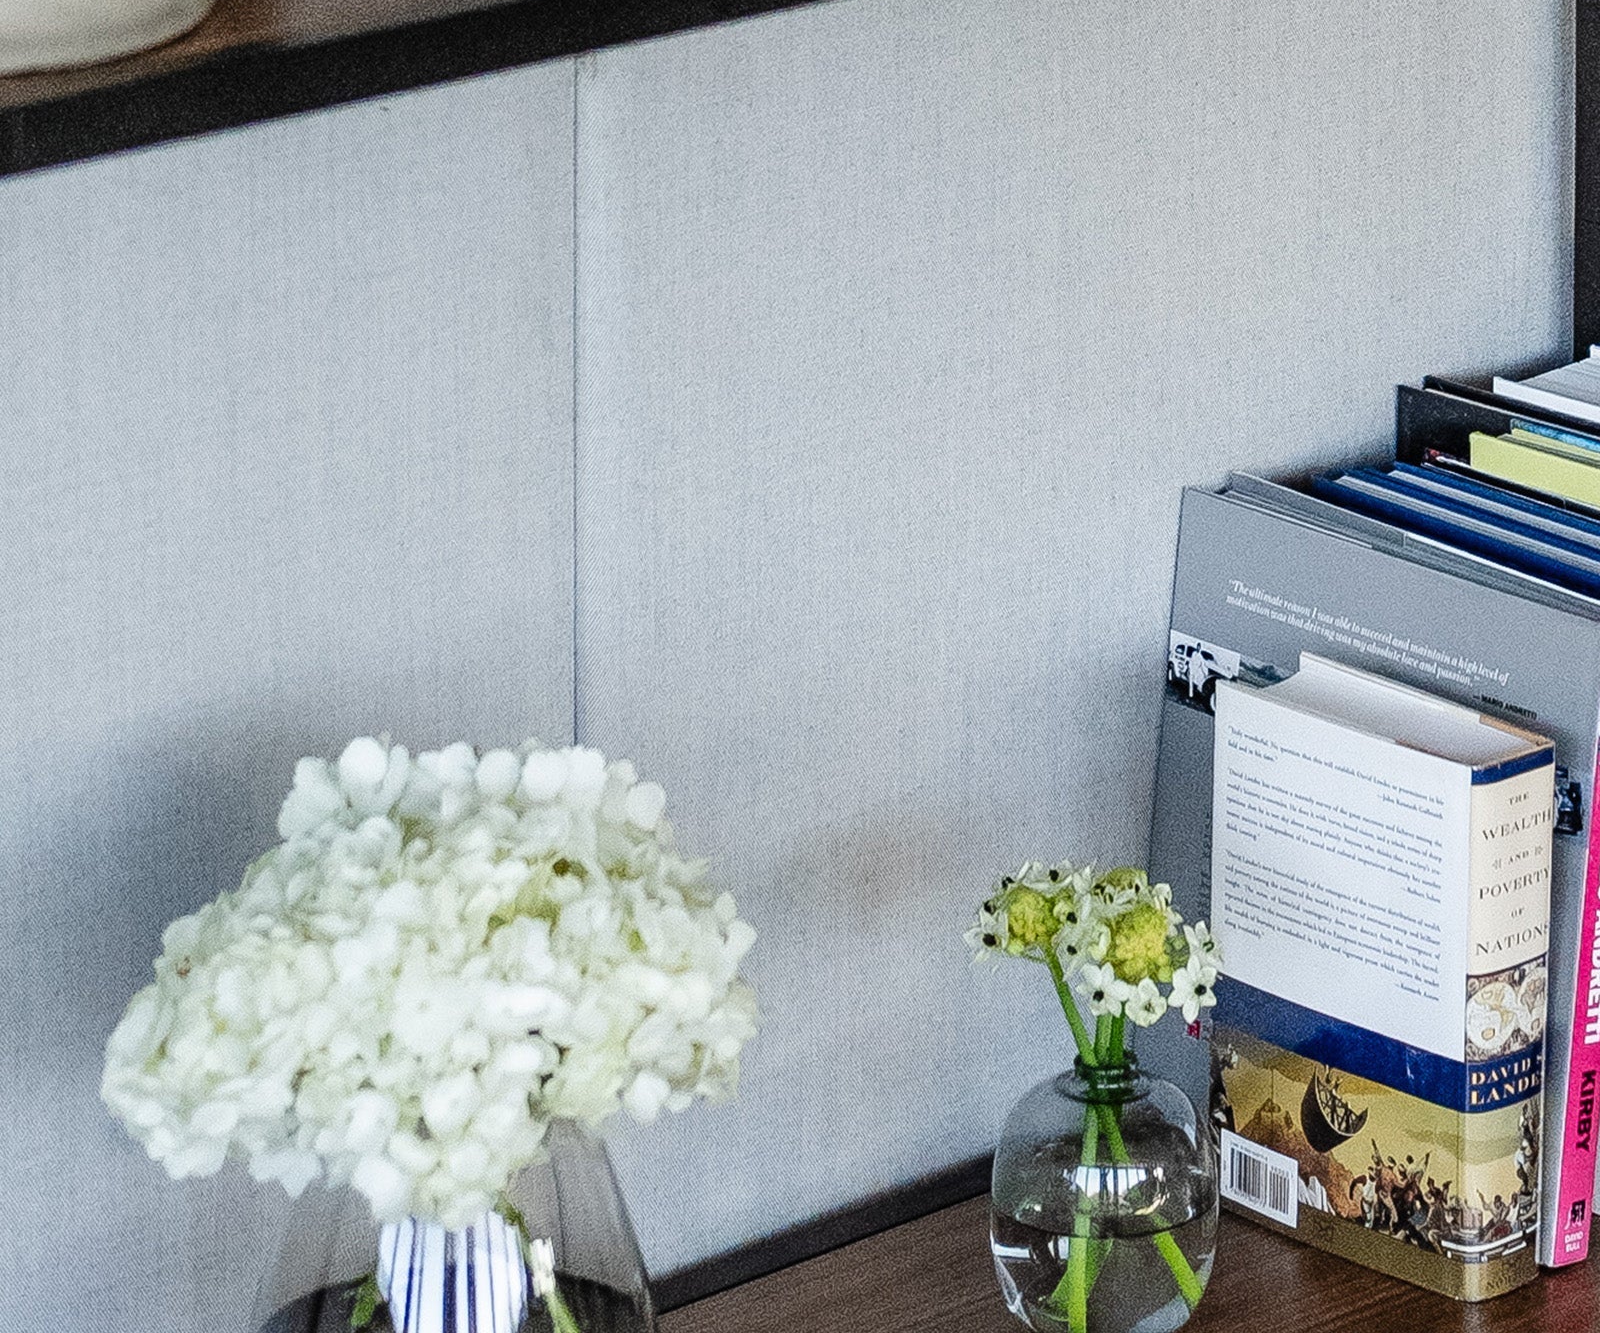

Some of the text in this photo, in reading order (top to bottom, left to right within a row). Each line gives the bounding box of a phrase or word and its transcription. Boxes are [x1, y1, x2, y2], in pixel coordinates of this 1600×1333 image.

[1226, 594, 1271, 616] motivation
[1271, 610, 1288, 622] was
[1288, 613, 1304, 629] that
[1304, 618, 1335, 642] driving
[1336, 631, 1352, 644] was
[1352, 637, 1367, 652] my
[1367, 640, 1401, 661] absolute
[1419, 656, 1437, 673] and
[1250, 587, 1284, 607] ultimate
[1283, 599, 1311, 616] reason
[1312, 606, 1317, 618] I
[1318, 611, 1335, 623] was
[1334, 615, 1351, 630] able
[1352, 621, 1361, 634] to
[1361, 626, 1392, 643] succeed
[1392, 635, 1409, 650] and
[1410, 640, 1450, 664] maintain
[1457, 656, 1479, 674] high
[1498, 671, 1510, 686] of
[1509, 791, 1529, 806] THE
[1482, 806, 1553, 842] WEALTH
[1508, 850, 1530, 864] AND
[1479, 867, 1551, 900] POVERTY
[1510, 908, 1525, 918] OF
[1471, 1058, 1532, 1086] DAVID
[1576, 1070, 1596, 1153] KIRBY
